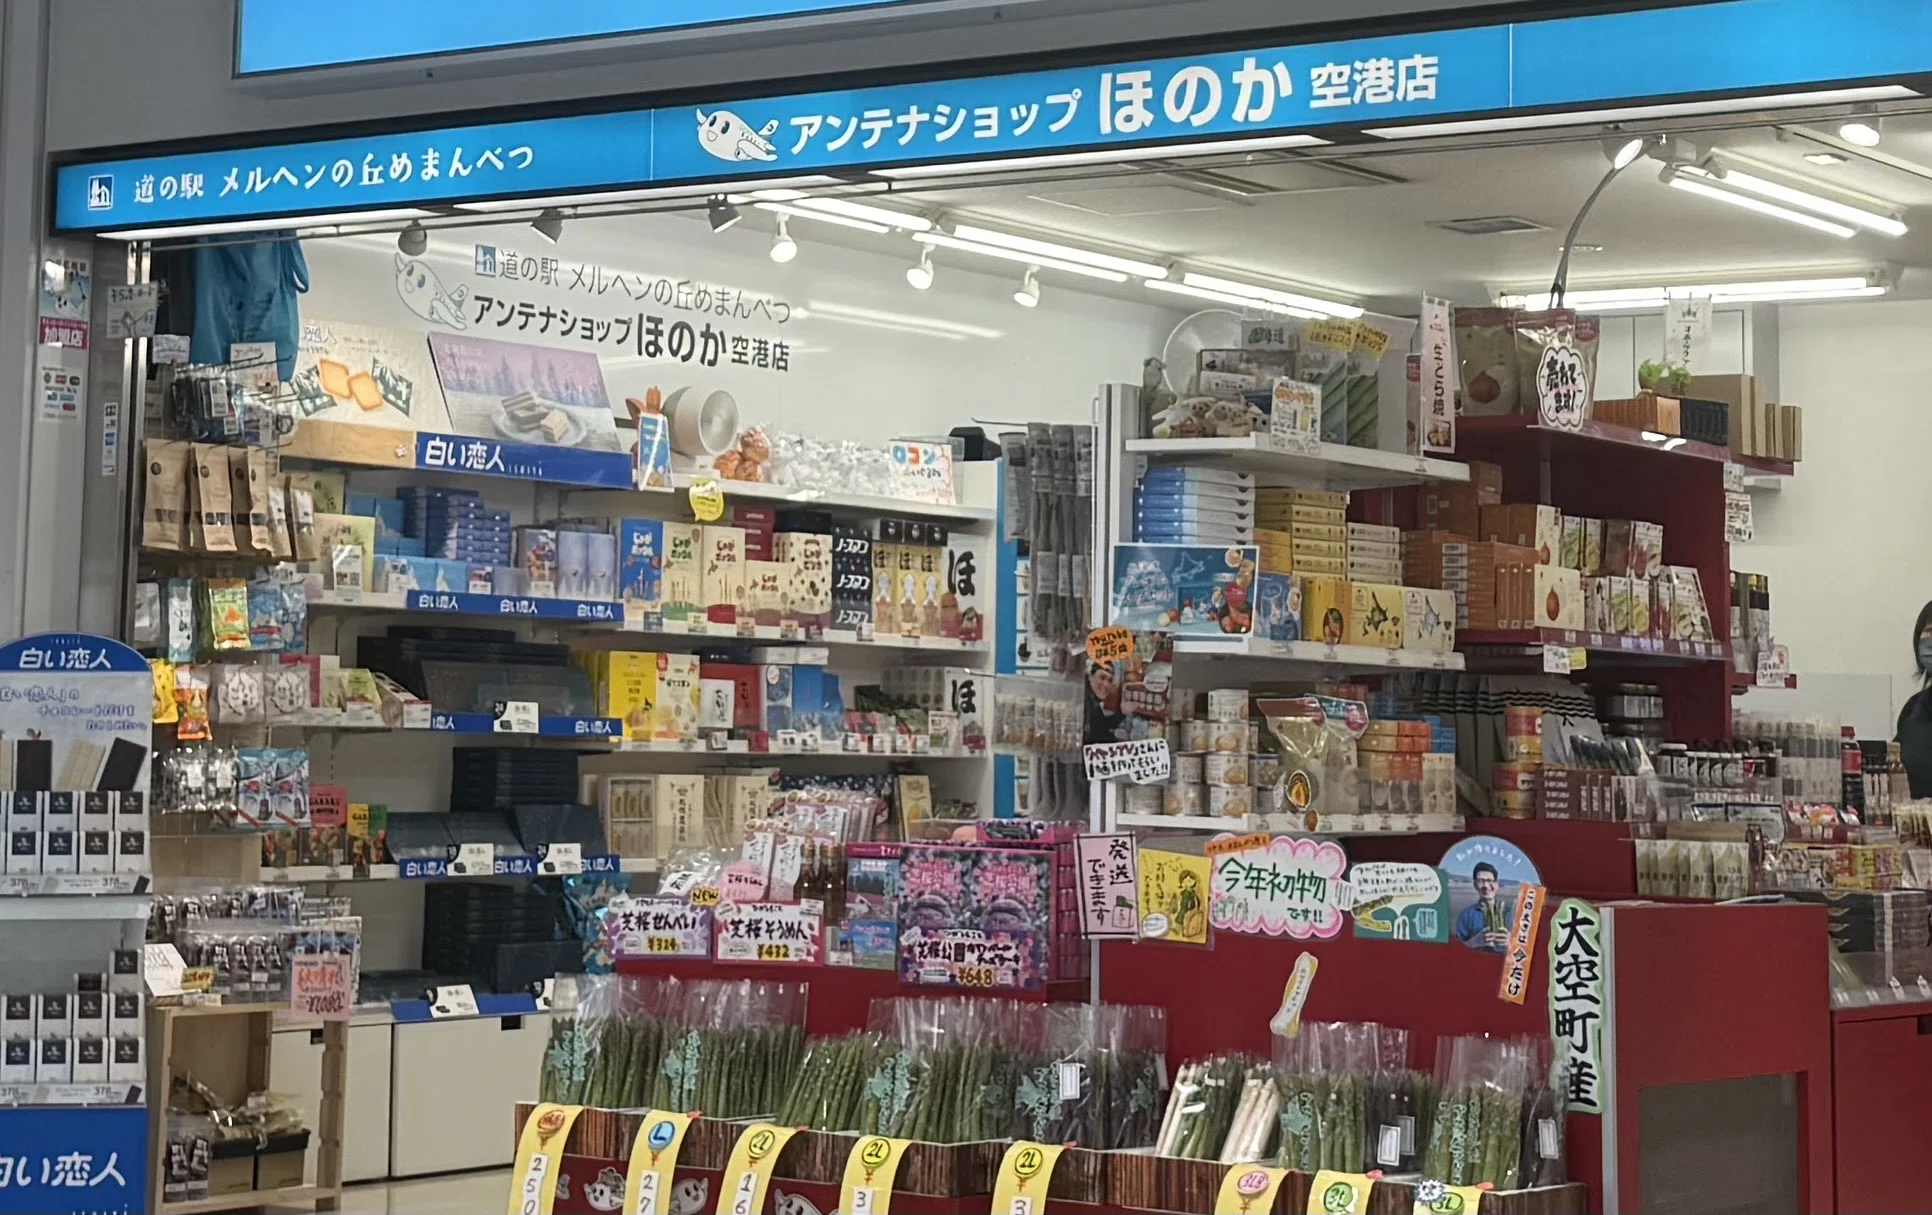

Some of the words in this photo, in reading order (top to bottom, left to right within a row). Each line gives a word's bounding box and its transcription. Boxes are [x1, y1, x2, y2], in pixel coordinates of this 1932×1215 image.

[789, 88, 1084, 155] アンテナショップ
[1099, 57, 1294, 135] ほのか
[1309, 54, 1439, 108] 空港店
[133, 173, 205, 205] 道の駅
[218, 145, 534, 198] メルヘンの丘めまんべつ
[498, 250, 560, 288] 道の駅
[568, 263, 792, 325] メルヘンの丘めまんべつ
[472, 293, 634, 346] アンテナショップ
[636, 312, 729, 368] ほのか
[730, 334, 791, 373] 空港店
[425, 436, 505, 472] 白い恋人
[948, 549, 976, 597] ほ
[19, 647, 112, 670] 白い恋人
[951, 678, 976, 714] ほ
[1108, 838, 1133, 885] 発送
[693, 889, 719, 902] NEW
[1087, 859, 1111, 926] できます
[1218, 857, 1327, 904] 今年初物
[620, 911, 697, 932] 芝桜せんべい
[729, 918, 808, 941] 芝桜そうめん
[758, 944, 790, 959] ¥432
[958, 967, 993, 986] ¥648
[1553, 906, 1600, 1107] 大空町産
[866, 1141, 882, 1160] 2L
[1018, 1150, 1036, 1169] 2L
